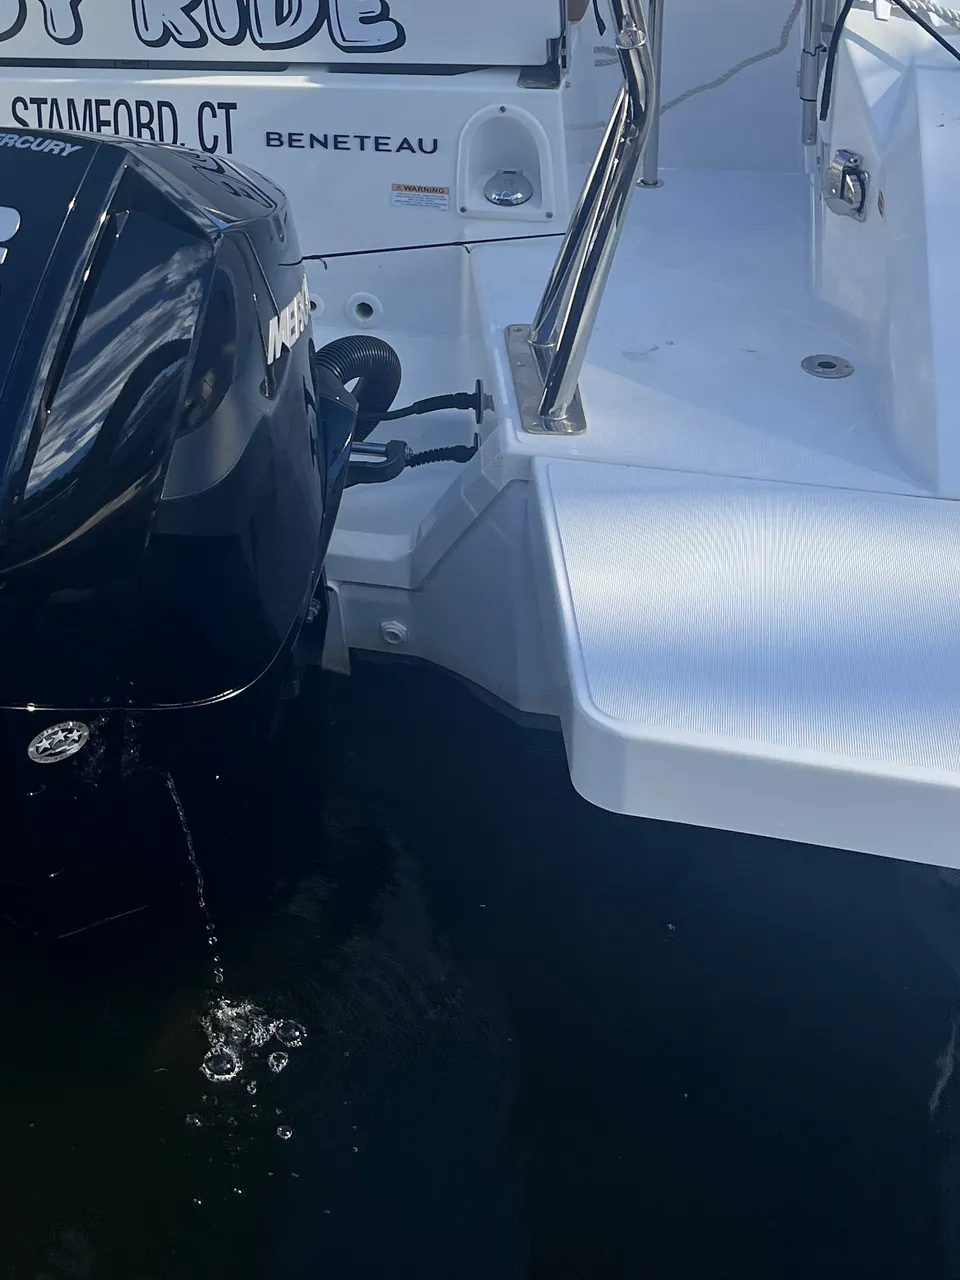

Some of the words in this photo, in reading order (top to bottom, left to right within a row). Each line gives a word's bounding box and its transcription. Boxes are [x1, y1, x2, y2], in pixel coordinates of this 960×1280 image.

[197, 100, 238, 155] CT
[265, 131, 439, 155] BENETEAU
[403, 185, 445, 195] WARNING
